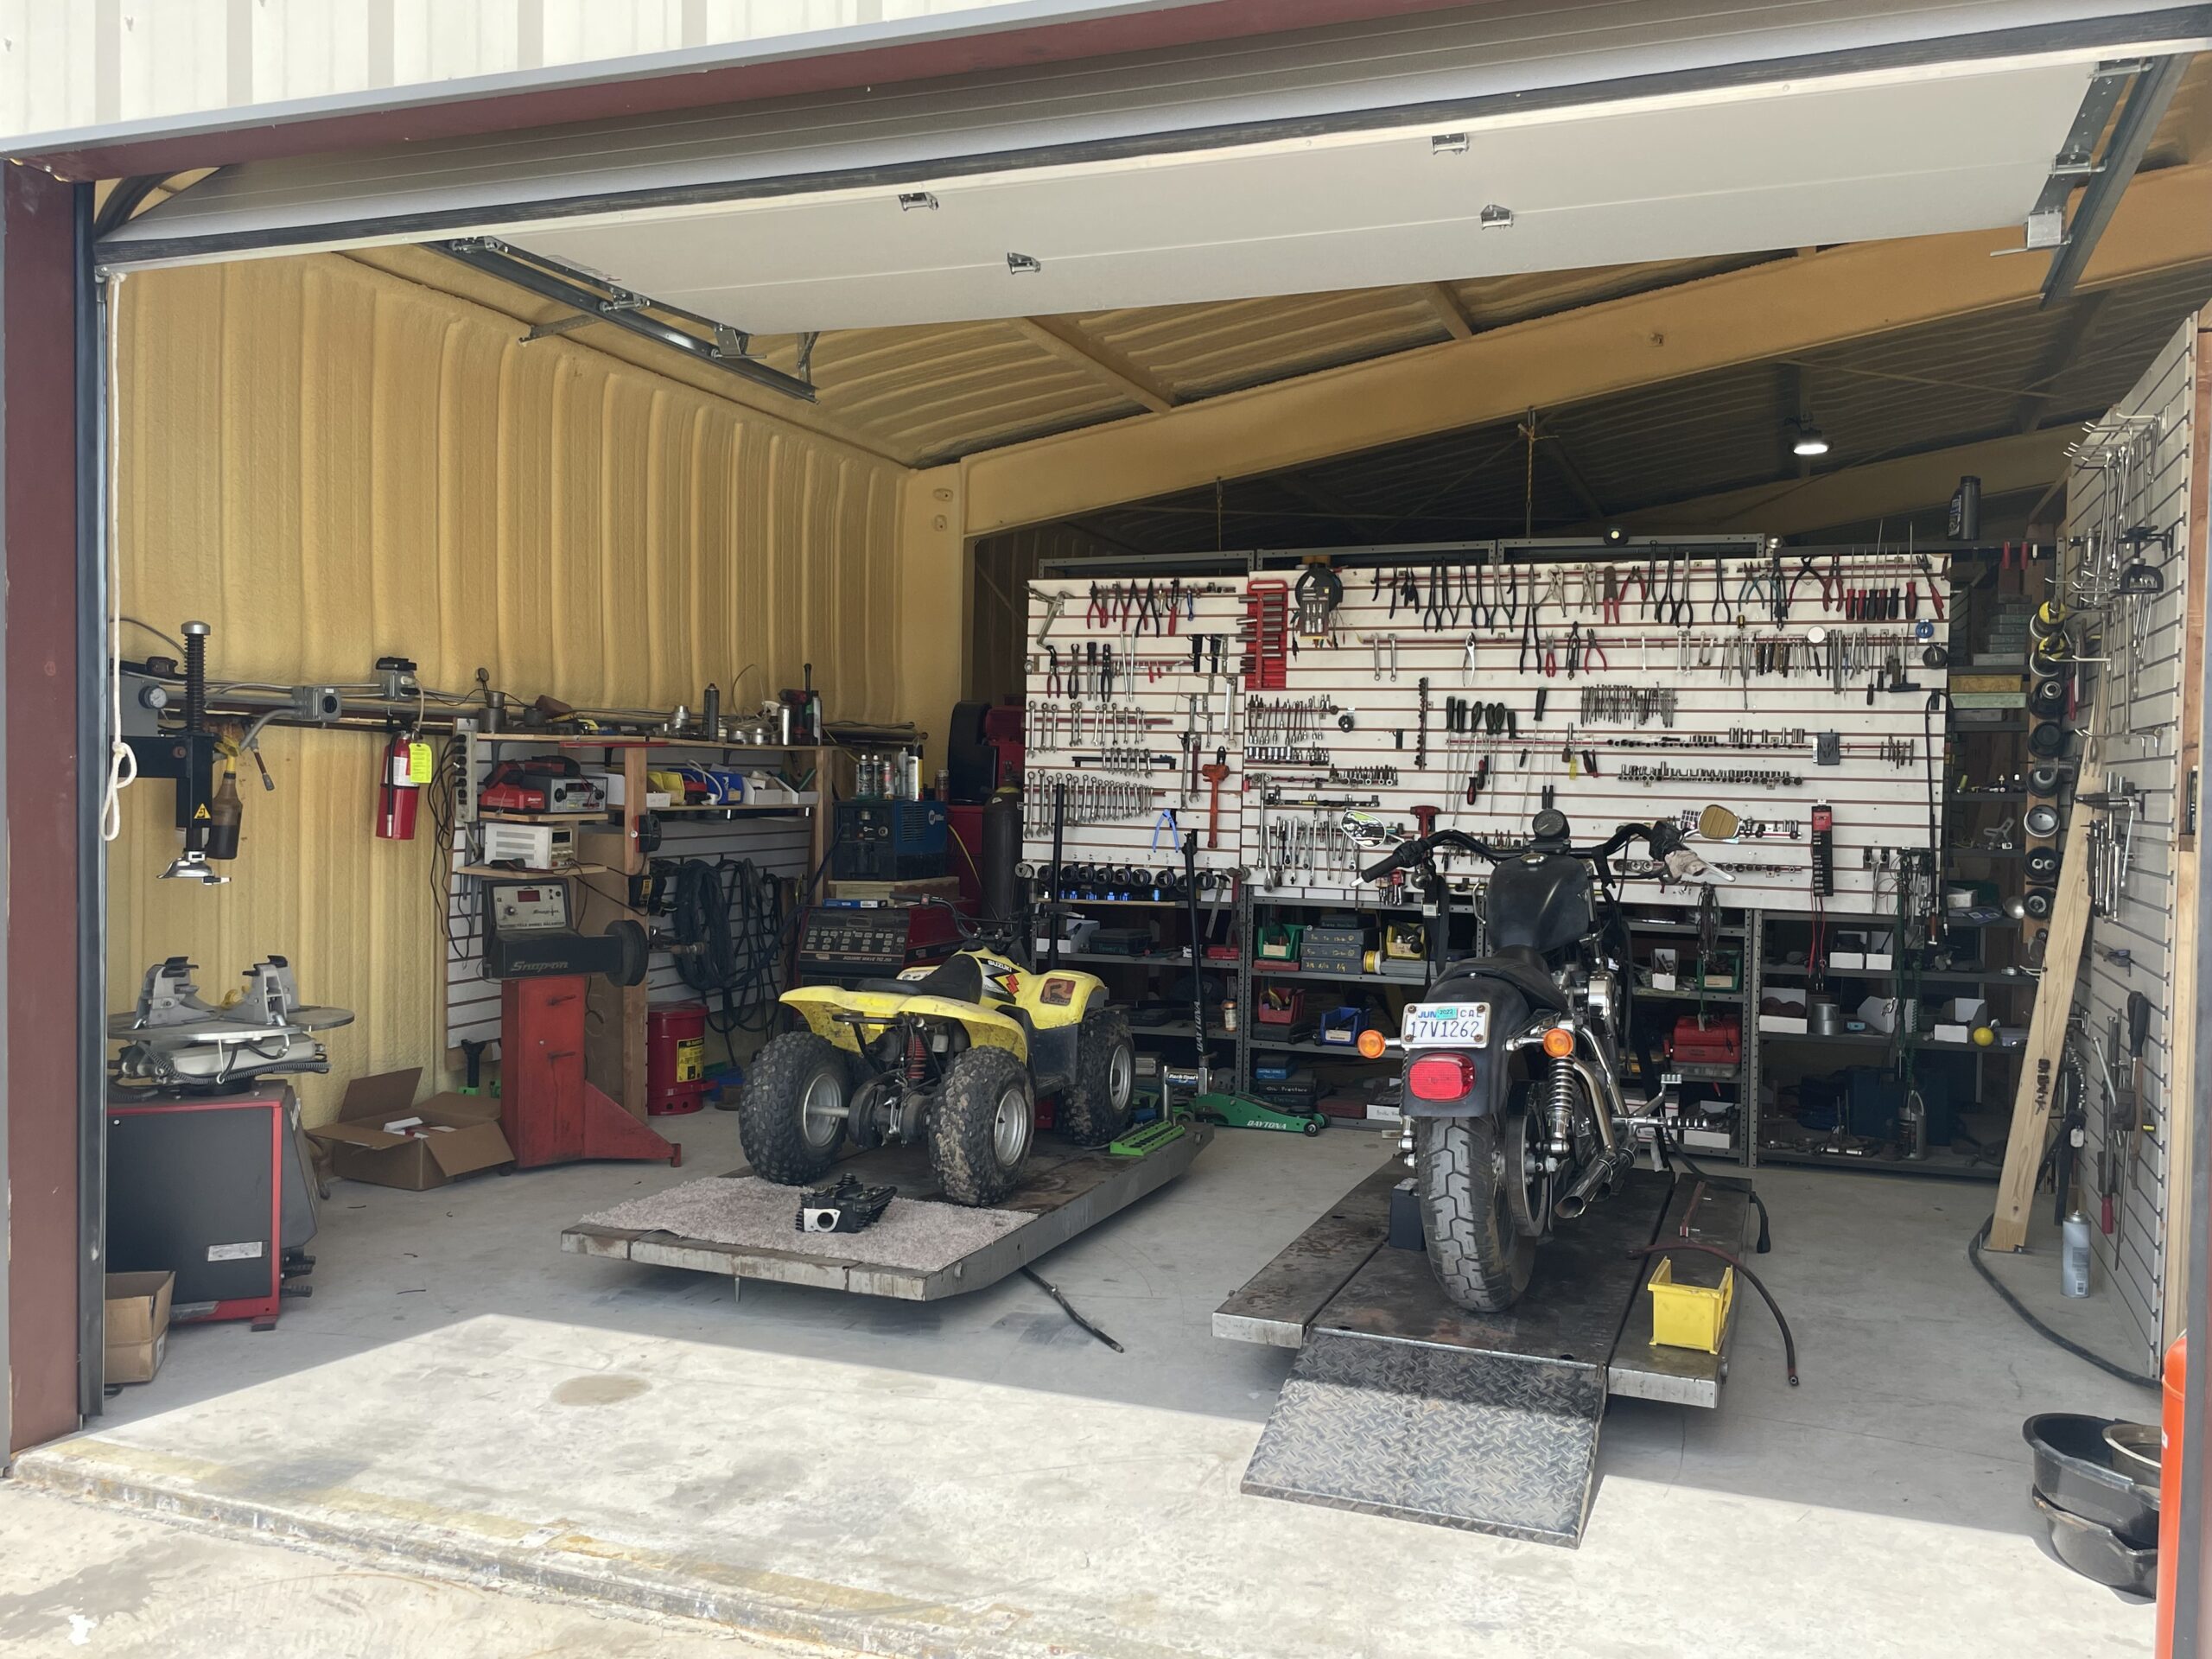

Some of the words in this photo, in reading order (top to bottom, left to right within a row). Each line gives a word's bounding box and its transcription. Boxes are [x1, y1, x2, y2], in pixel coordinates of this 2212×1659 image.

[511, 960, 569, 973] Snap-on
[988, 959, 1012, 973] SUZUKI
[1193, 1000, 1205, 1052] DAYTONA
[1410, 1020, 1479, 1037] 17V1262
[1247, 1120, 1287, 1129] DAYTONA
